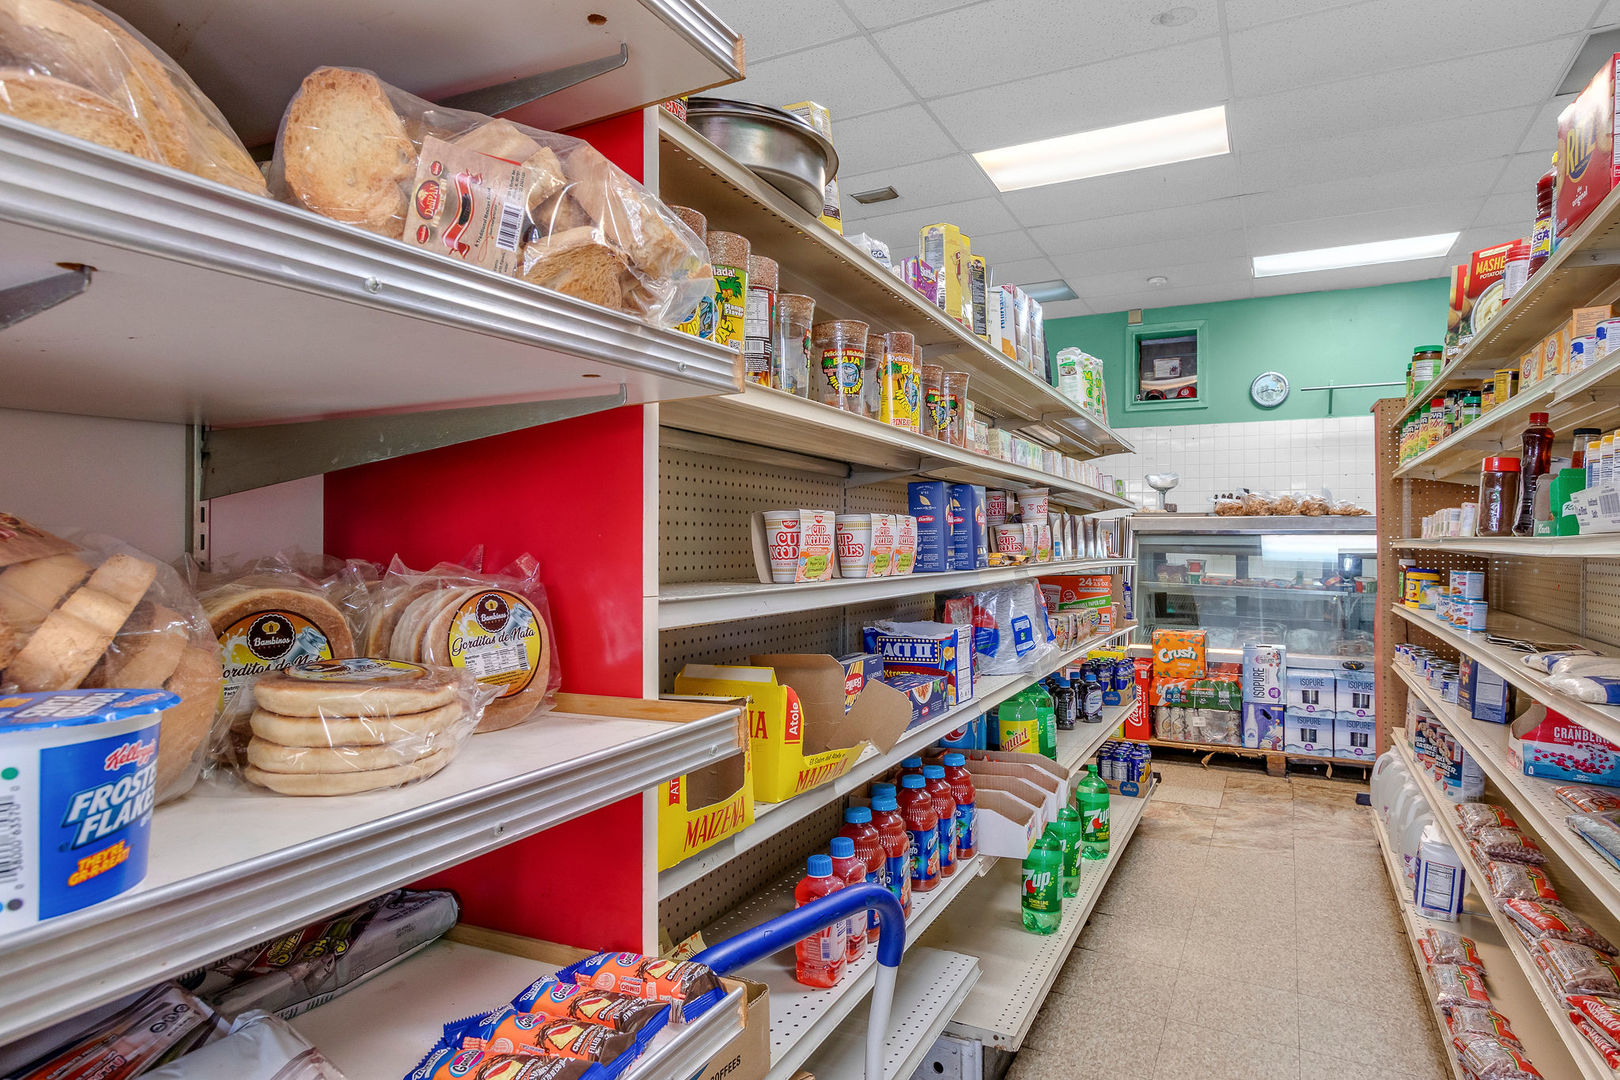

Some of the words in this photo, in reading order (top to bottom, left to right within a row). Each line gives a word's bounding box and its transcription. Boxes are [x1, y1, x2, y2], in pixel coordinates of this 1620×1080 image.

[1566, 125, 1596, 176] RITZ
[1476, 255, 1506, 275] MASHE
[811, 524, 826, 535] CUP
[776, 531, 801, 546] CU
[805, 534, 831, 546] NOODLES
[1079, 577, 1092, 586] 24
[481, 612, 507, 622] Bambinos
[253, 636, 291, 647] Bambinos
[451, 635, 496, 657] Gorditas
[499, 631, 510, 643] de
[511, 626, 536, 641] Nata
[883, 642, 912, 657] ACT
[914, 643, 933, 658] II
[1158, 647, 1197, 664] Crush
[223, 662, 271, 679] orditas
[275, 659, 291, 672] de
[293, 655, 324, 666] Nat
[1253, 667, 1265, 698] ISOPURE
[1300, 678, 1325, 686] ISOPURE
[1348, 680, 1373, 691] ISOPURE
[1128, 685, 1143, 727] CocaCola
[789, 702, 800, 735] Atole
[1297, 716, 1321, 725] ISOPURE
[1347, 720, 1372, 729] ISOPURE
[795, 757, 848, 793] MAIZENA
[684, 795, 745, 852] MAIZENA
[1084, 808, 1110, 834] 7up
[1022, 868, 1051, 897] 7up
